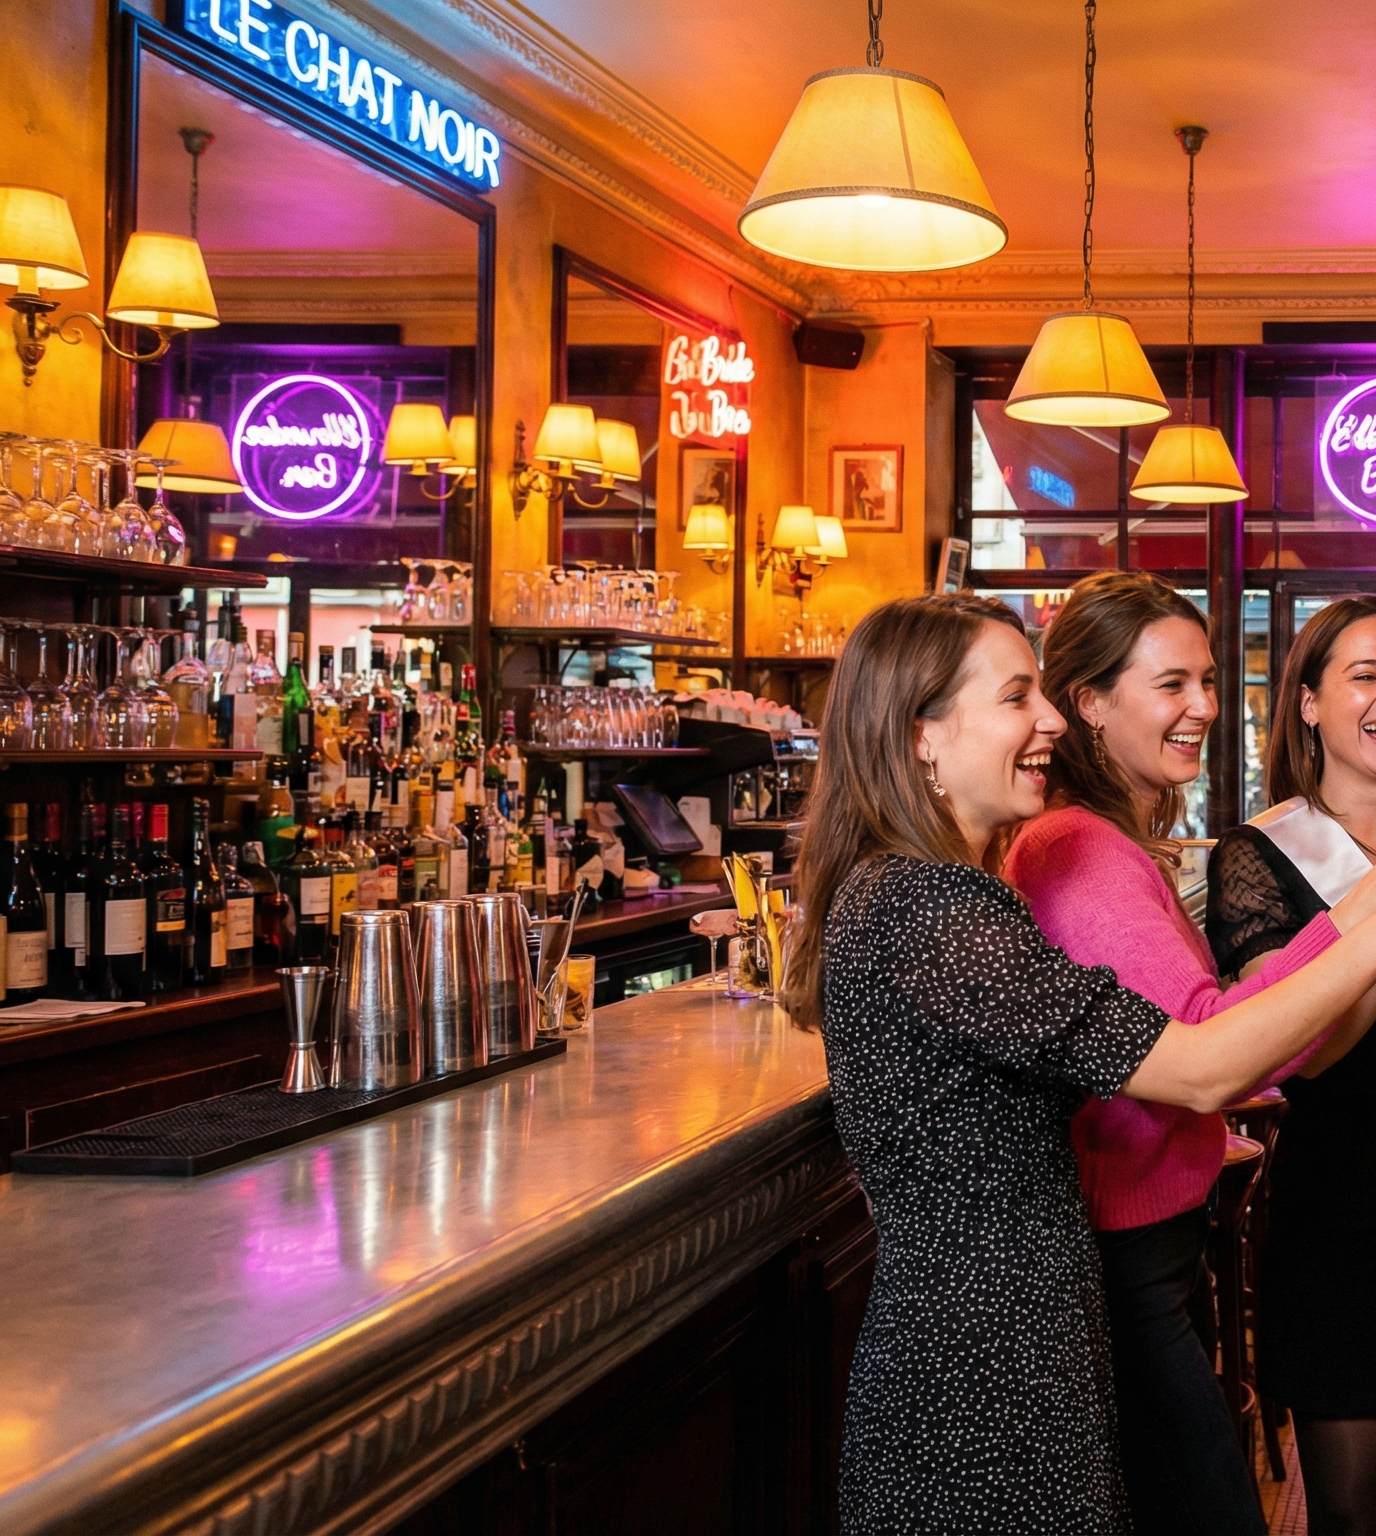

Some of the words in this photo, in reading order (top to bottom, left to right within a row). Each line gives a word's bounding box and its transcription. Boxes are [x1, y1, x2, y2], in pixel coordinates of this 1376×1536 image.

[209, 0, 272, 61] LE
[285, 20, 402, 125] CHAT
[408, 90, 500, 188] NOIR
